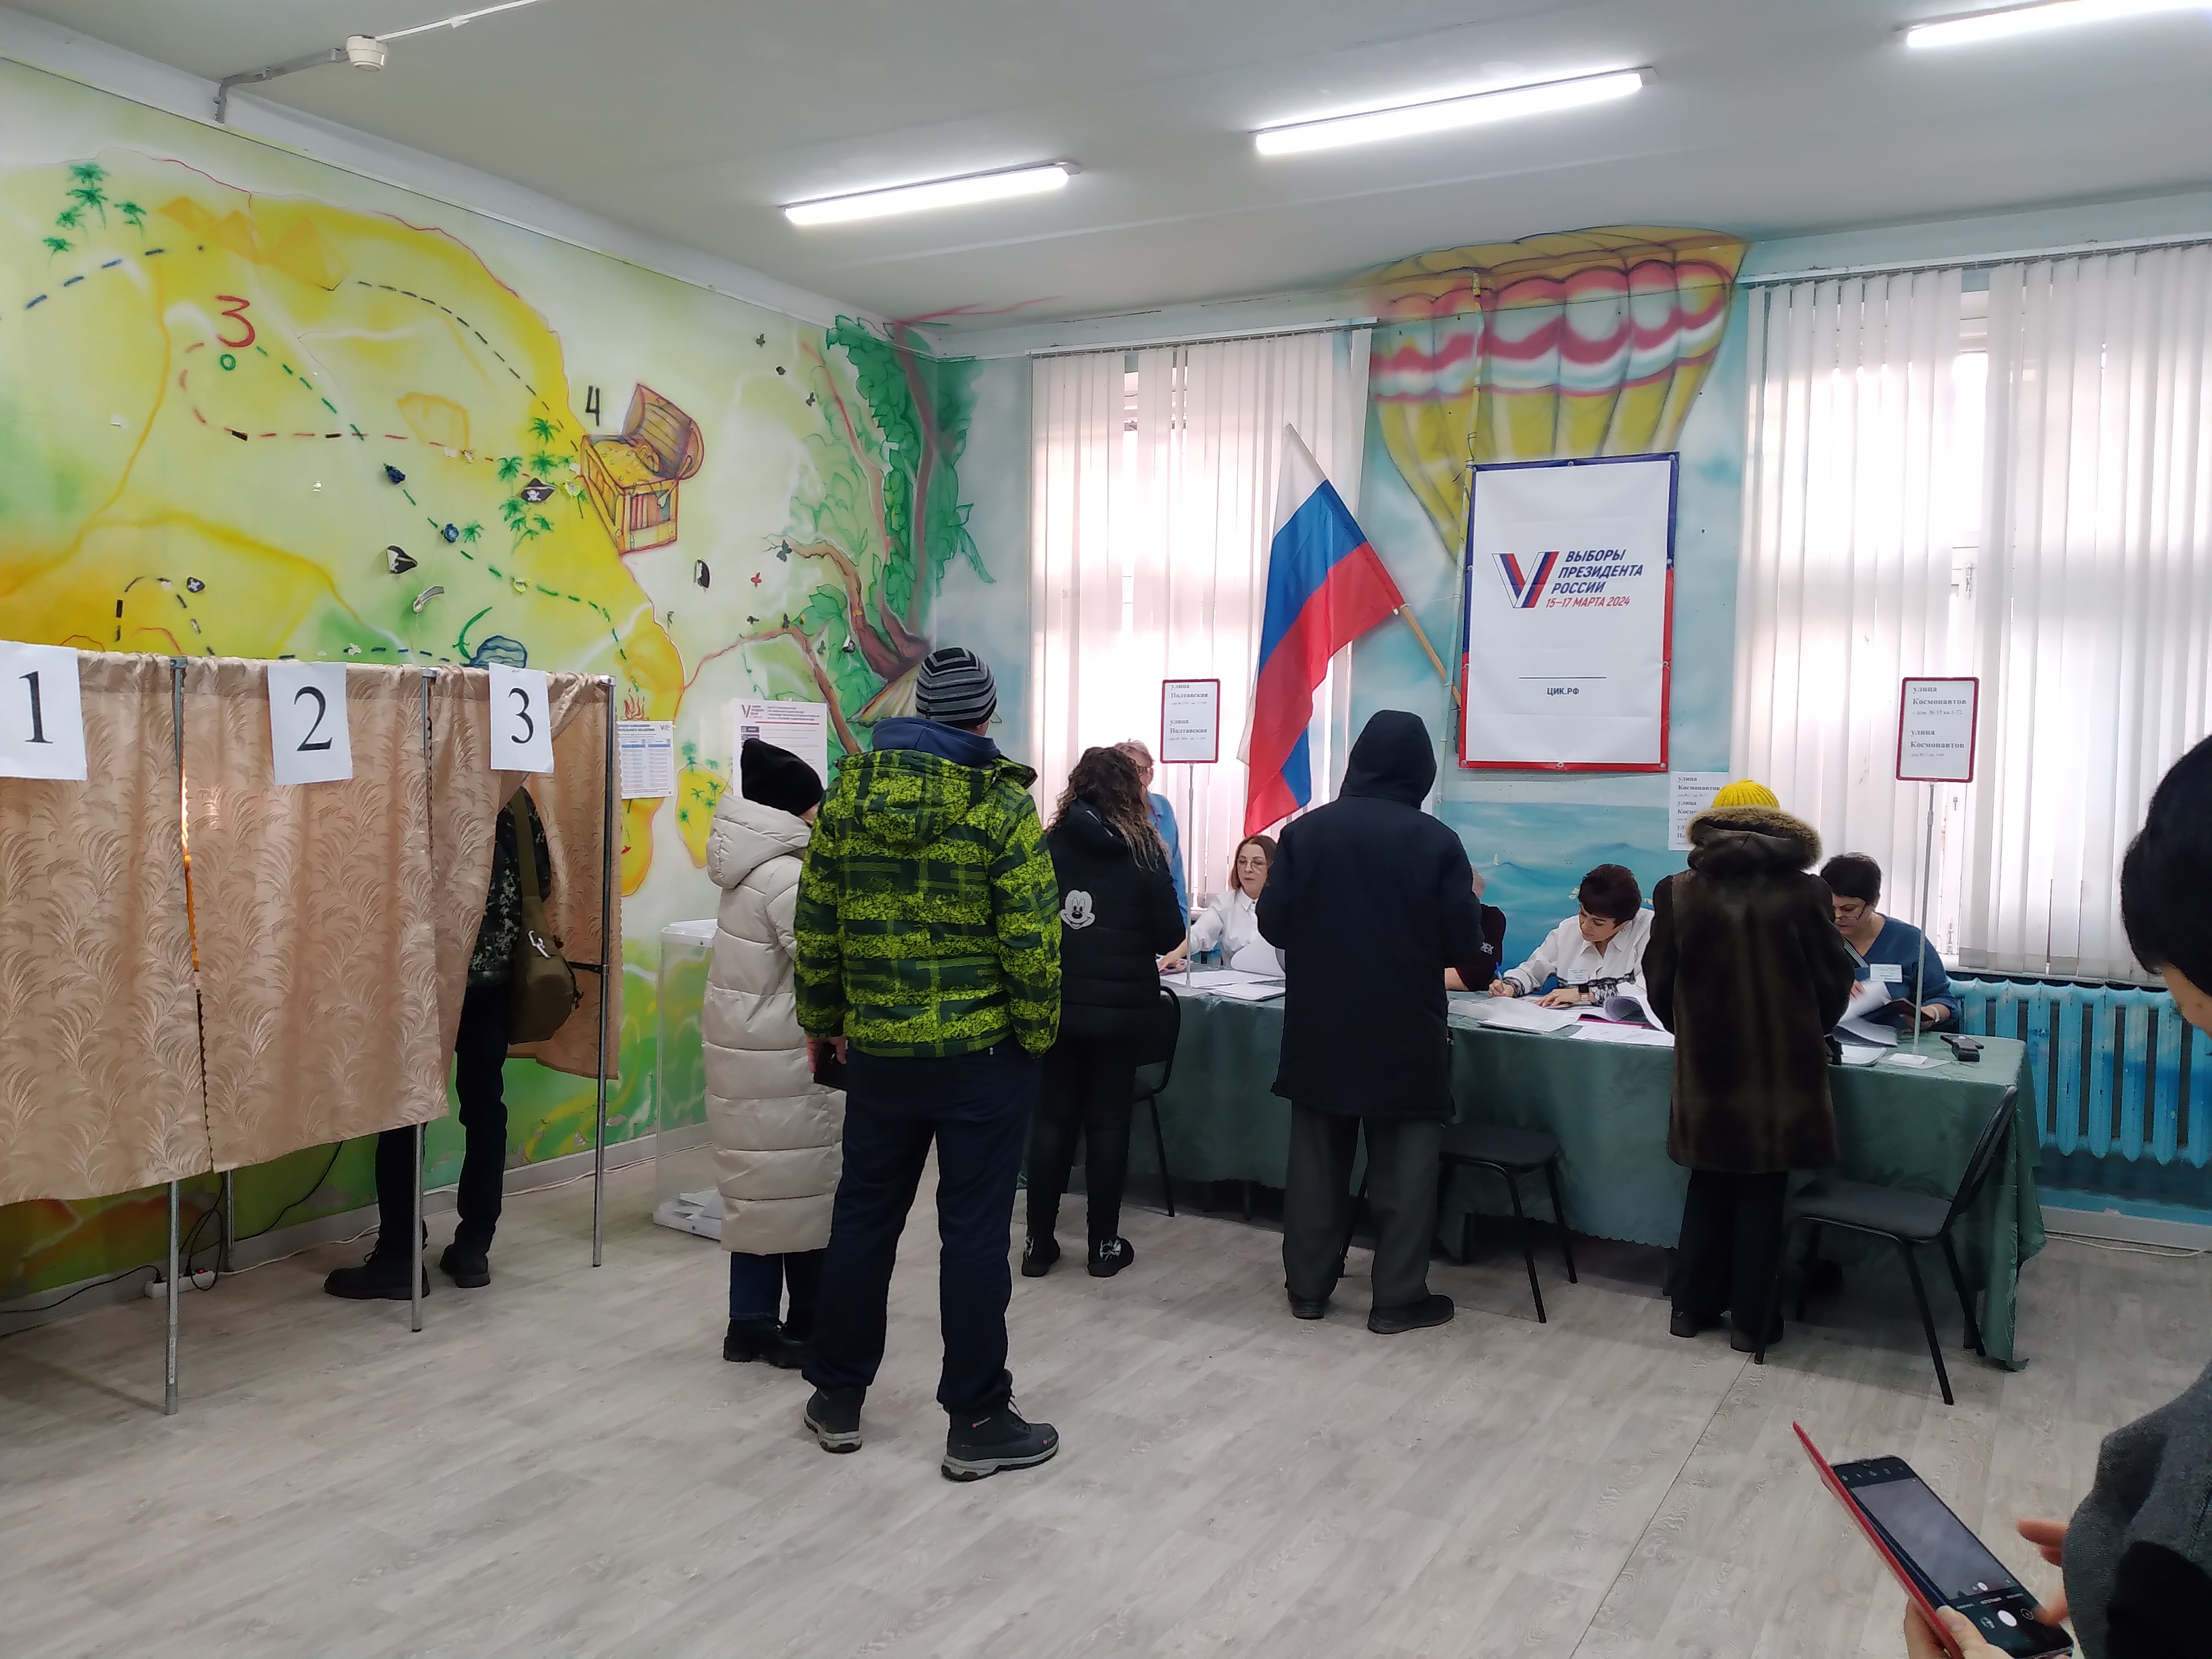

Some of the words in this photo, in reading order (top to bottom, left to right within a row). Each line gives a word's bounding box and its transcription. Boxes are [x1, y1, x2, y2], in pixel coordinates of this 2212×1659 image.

[215, 295, 255, 348] 3
[585, 386, 600, 426] 4
[1565, 549, 1627, 563] ВЫБОРЫ
[1557, 564, 1644, 580] ПРЕЗИДЕНТА
[1551, 581, 1607, 594] РОССИИ
[1572, 597, 1606, 607] МАРТА
[1606, 596, 1631, 607] 2024
[1547, 687, 1580, 697] ЦИК.РФ
[19, 671, 53, 744] 1
[293, 686, 333, 751] 2
[507, 688, 534, 744] 3
